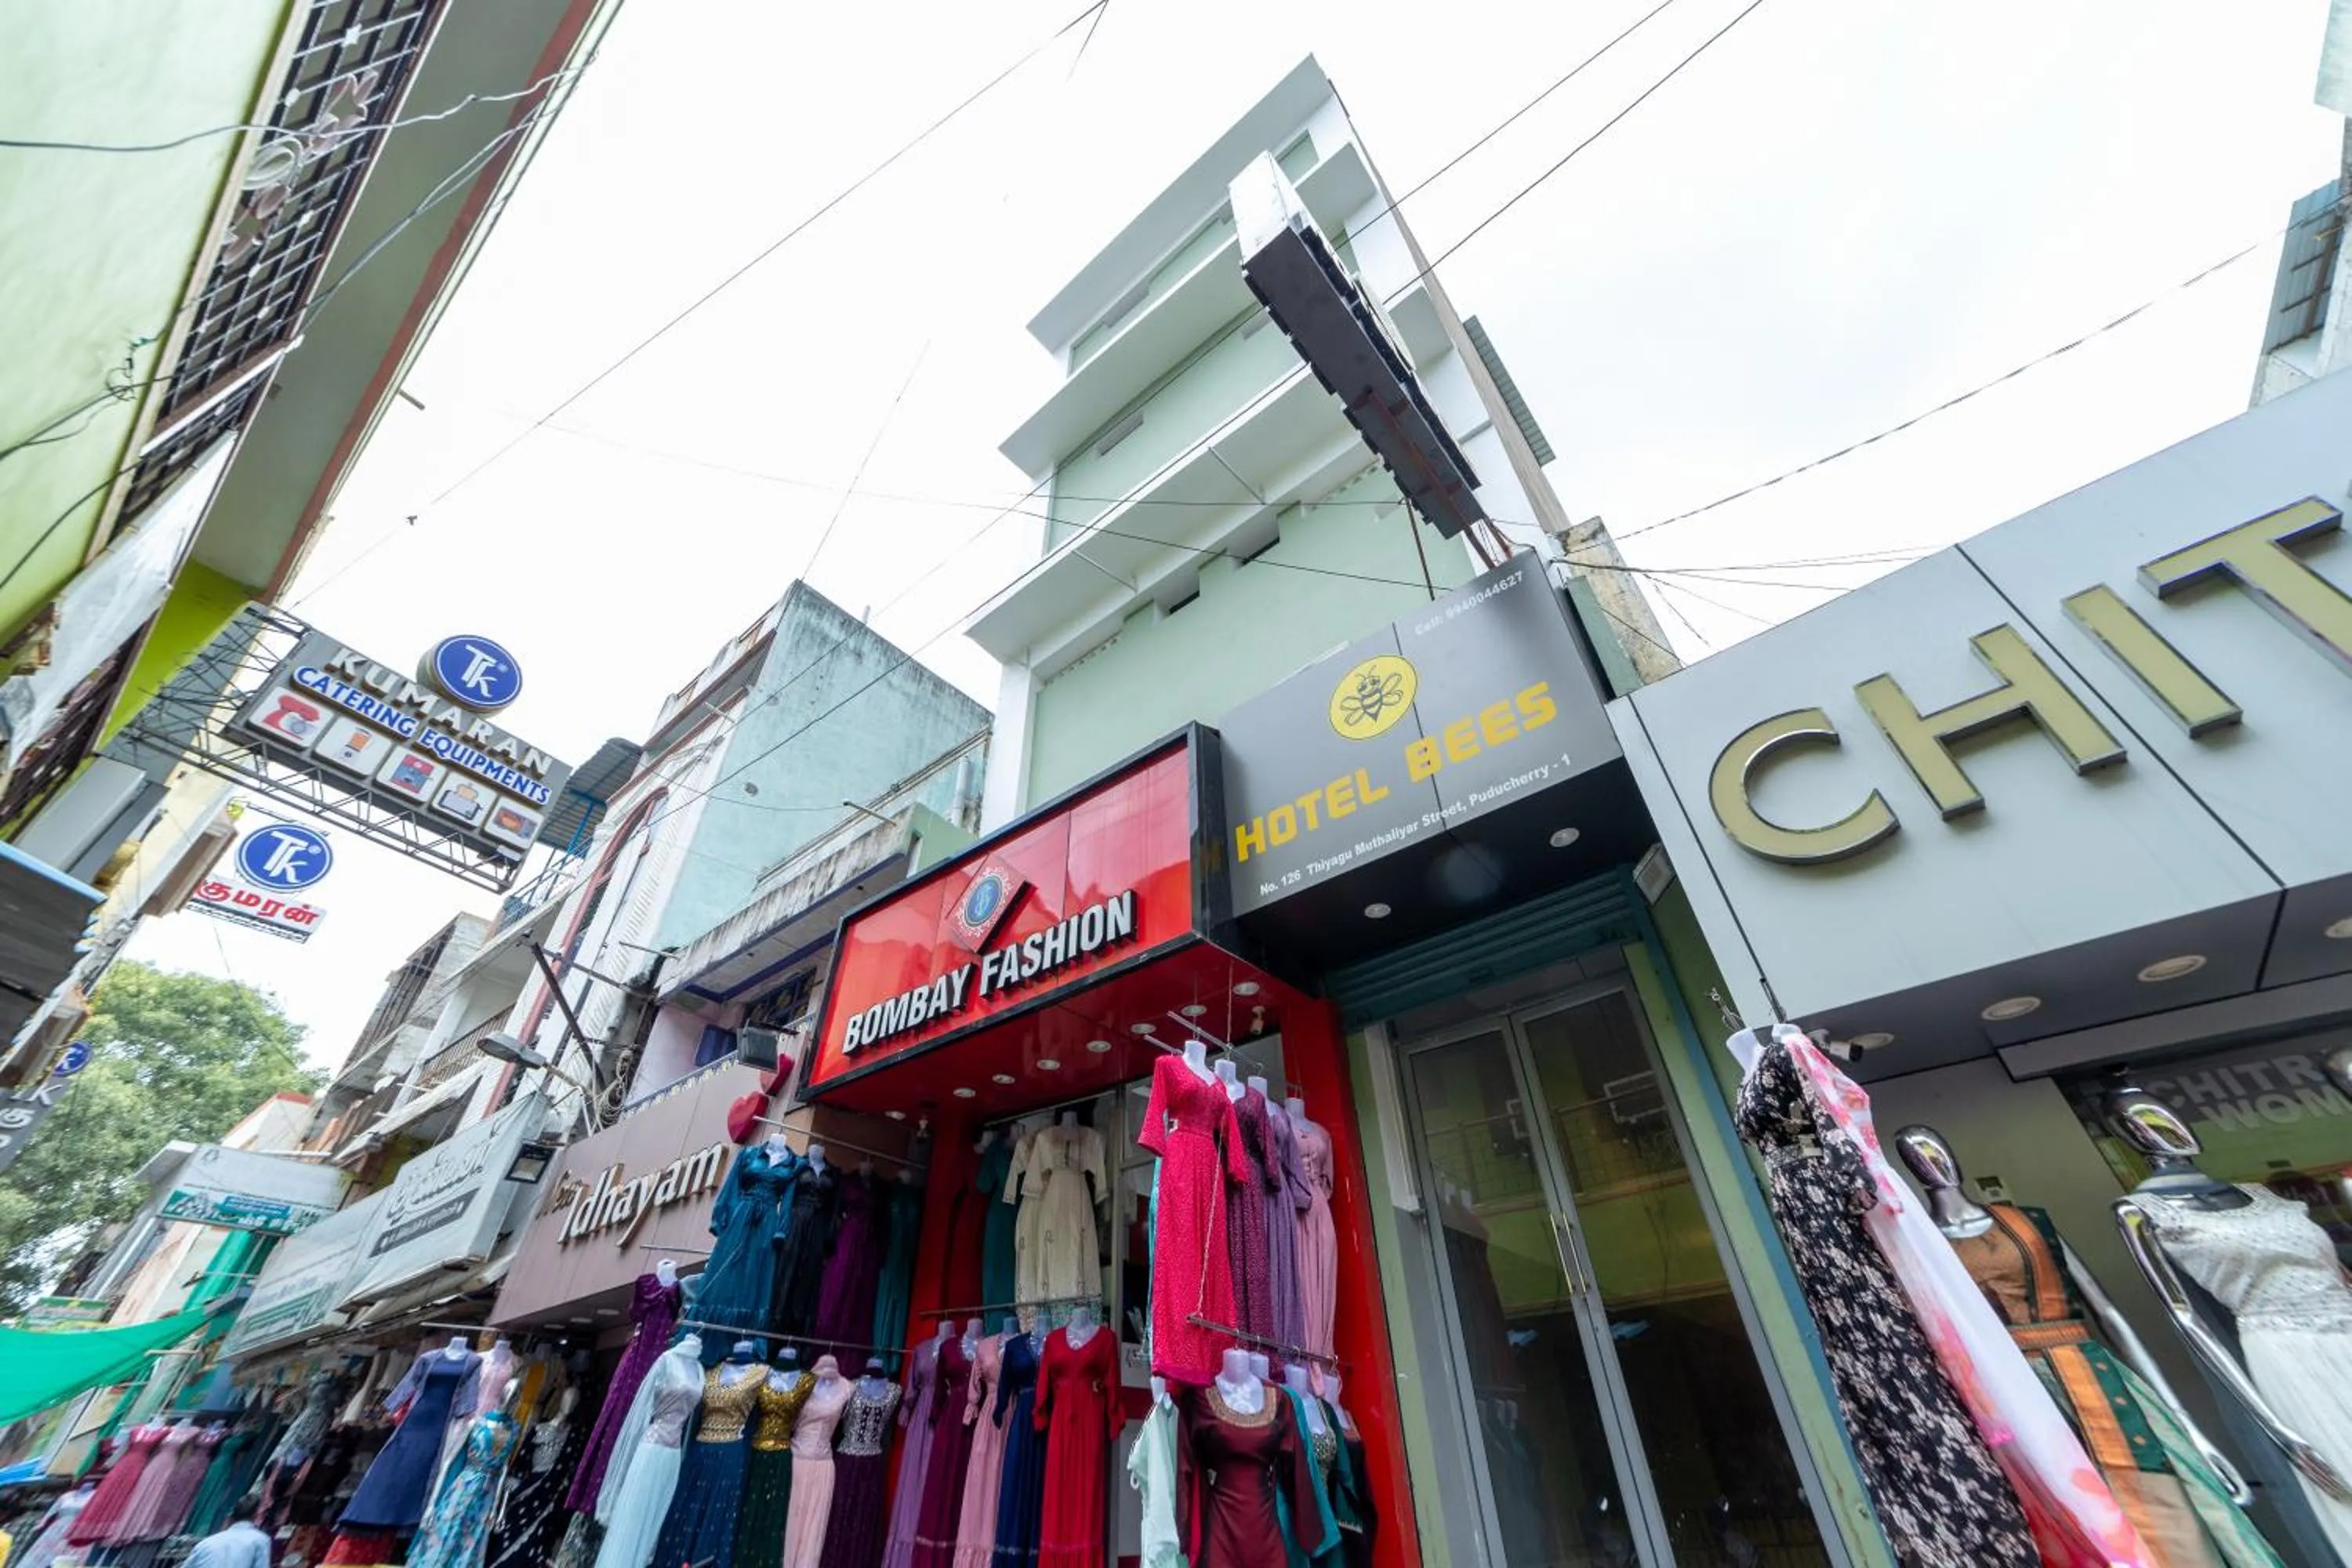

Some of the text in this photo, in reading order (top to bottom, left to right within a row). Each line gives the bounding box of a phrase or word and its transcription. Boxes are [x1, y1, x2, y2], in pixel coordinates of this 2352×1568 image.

[296, 667, 552, 805] CATERING EQUIPMENTS
[328, 648, 554, 777] KUMARAN
[1236, 681, 1558, 862] HOTEL BEES
[1259, 884, 1279, 896] No.
[1280, 869, 1301, 887] 126
[1469, 765, 1550, 808] Puducherry
[843, 891, 1134, 1055] BOMBAY FASHION
[2148, 1054, 2328, 1109] CHITR
[557, 1142, 726, 1249] Idhayam
